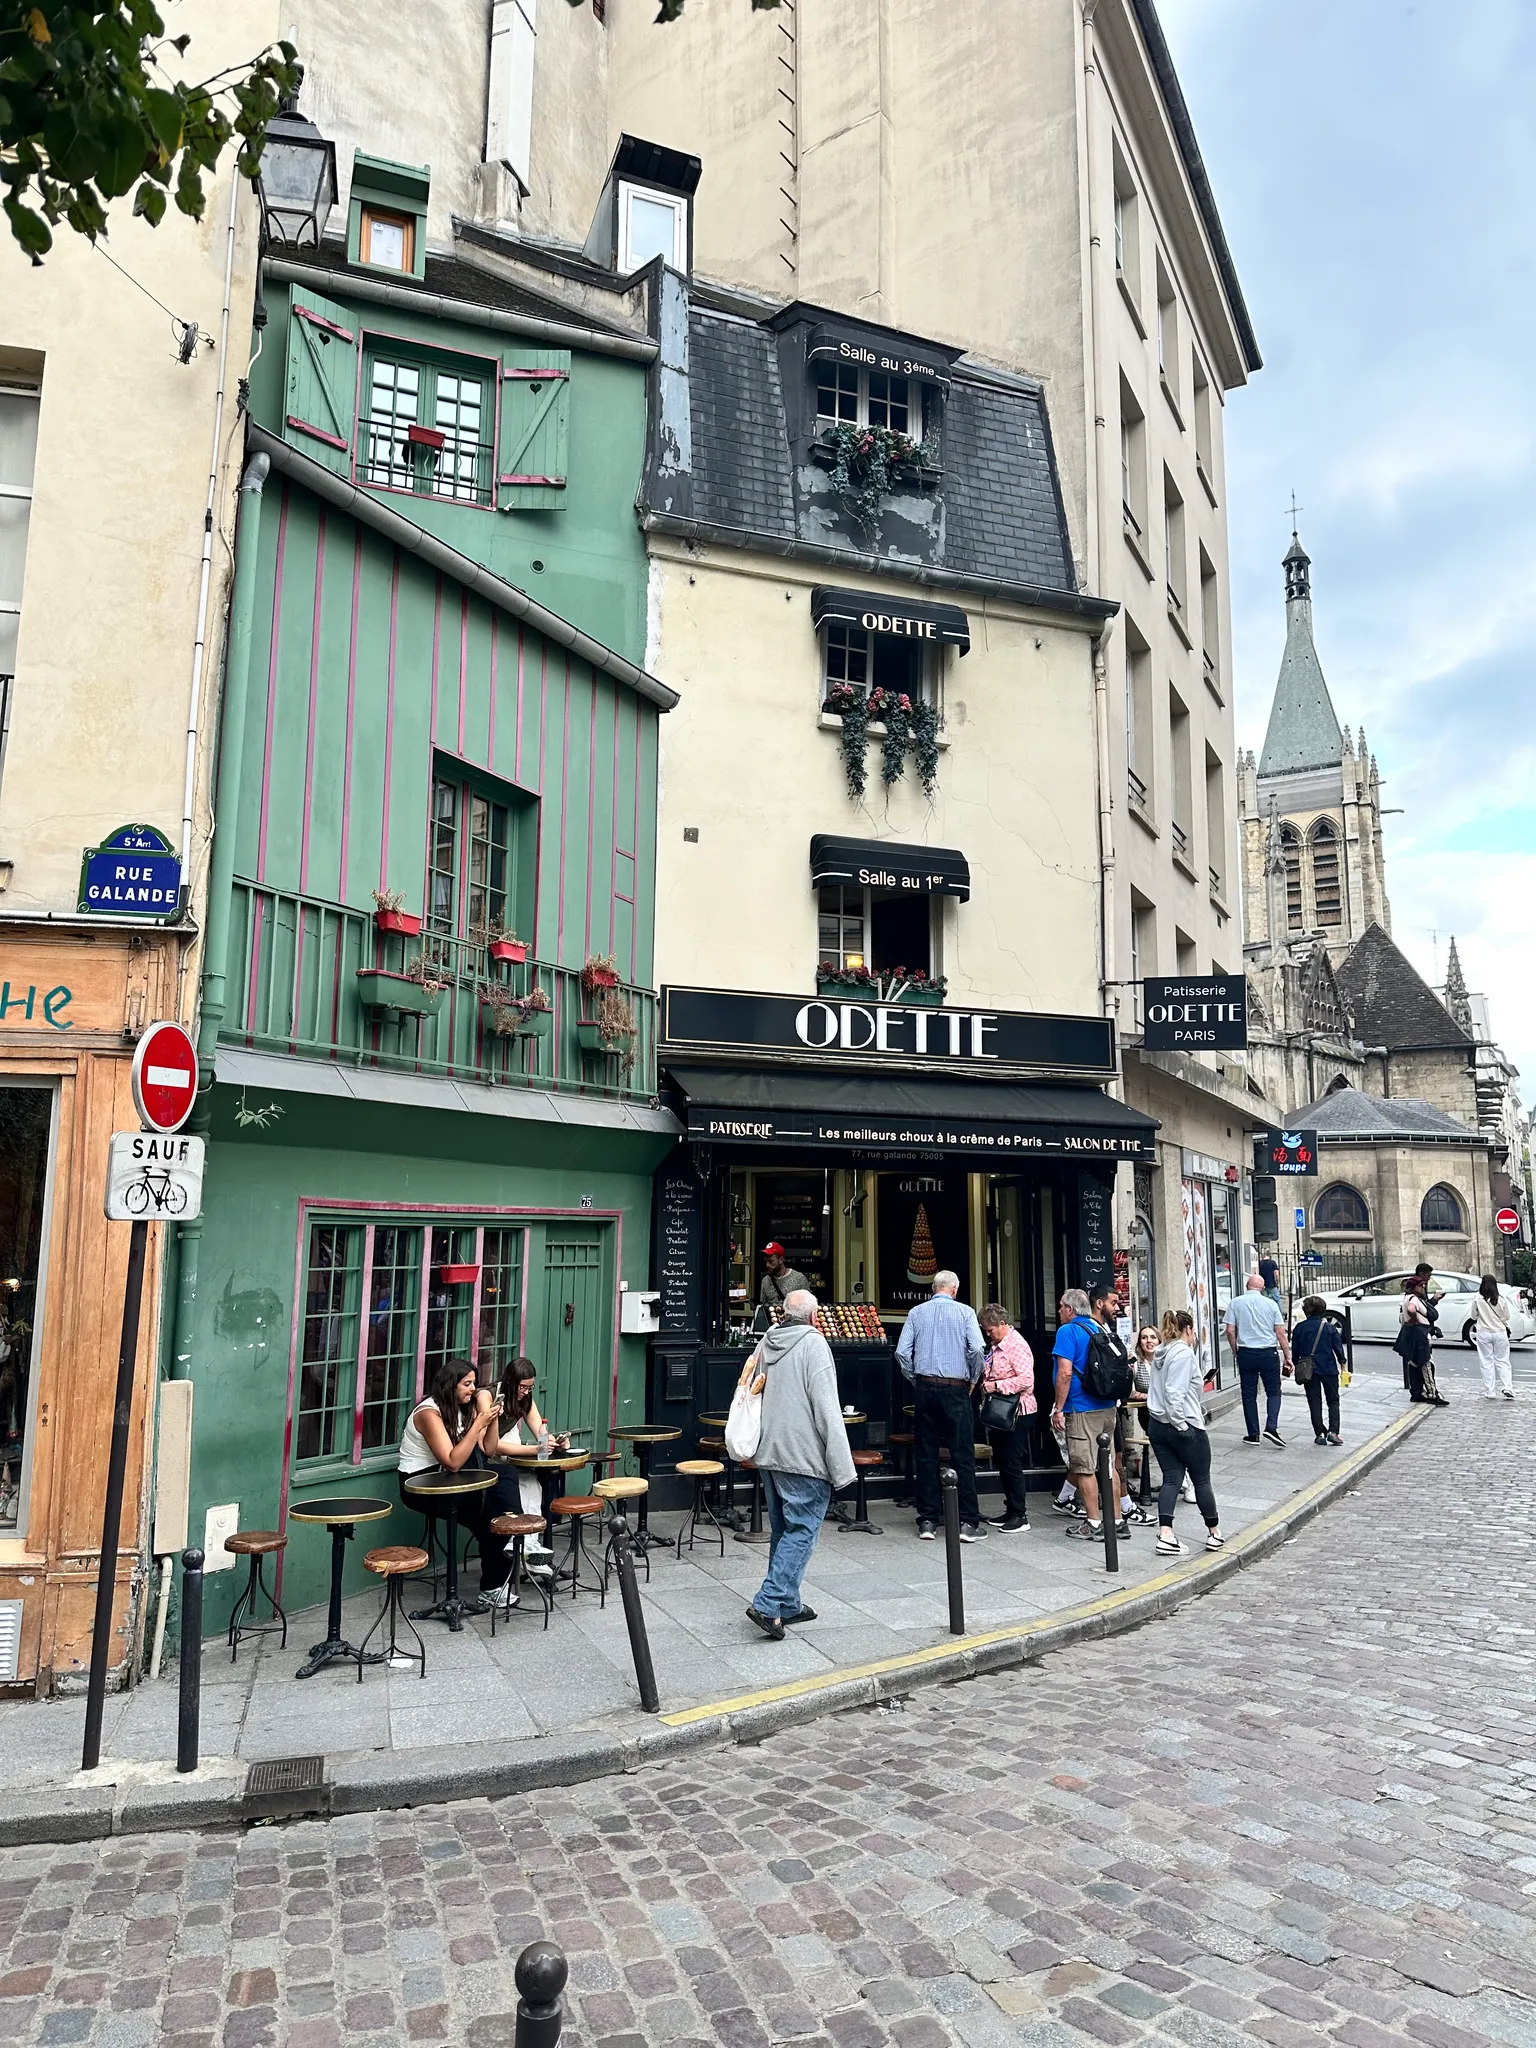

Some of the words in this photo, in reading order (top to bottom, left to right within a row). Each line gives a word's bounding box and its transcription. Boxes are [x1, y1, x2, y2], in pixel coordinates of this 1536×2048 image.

[840, 342, 876, 364] Salle
[881, 357, 898, 371] au
[861, 612, 937, 639] ODETTE
[115, 866, 153, 881] RUE
[858, 868, 897, 886] Salle
[901, 876, 920, 889] au
[925, 875, 944, 890] 1er
[88, 885, 176, 903] GALANDE
[1164, 984, 1227, 997] Patisserie
[1148, 1003, 1242, 1023] ODETTE
[795, 1001, 999, 1059] ODETTE
[1174, 1030, 1216, 1041] PARIS
[709, 1121, 774, 1139] PATISSERIE
[819, 1127, 840, 1139] Les
[843, 1128, 897, 1141] meilleurs
[899, 1130, 934, 1142] choux
[936, 1132, 944, 1143] à
[946, 1132, 957, 1144] la
[997, 1134, 1011, 1146] de
[1013, 1135, 1043, 1147] Paris
[132, 1138, 190, 1161] SAUF
[1064, 1136, 1101, 1150] SALON
[1103, 1139, 1118, 1151] DE
[883, 1151, 917, 1160] galande
[920, 1152, 944, 1160] 75005
[1279, 1163, 1307, 1174] soupe
[899, 1180, 945, 1192] ODETTE
[582, 1197, 592, 1207] 75
